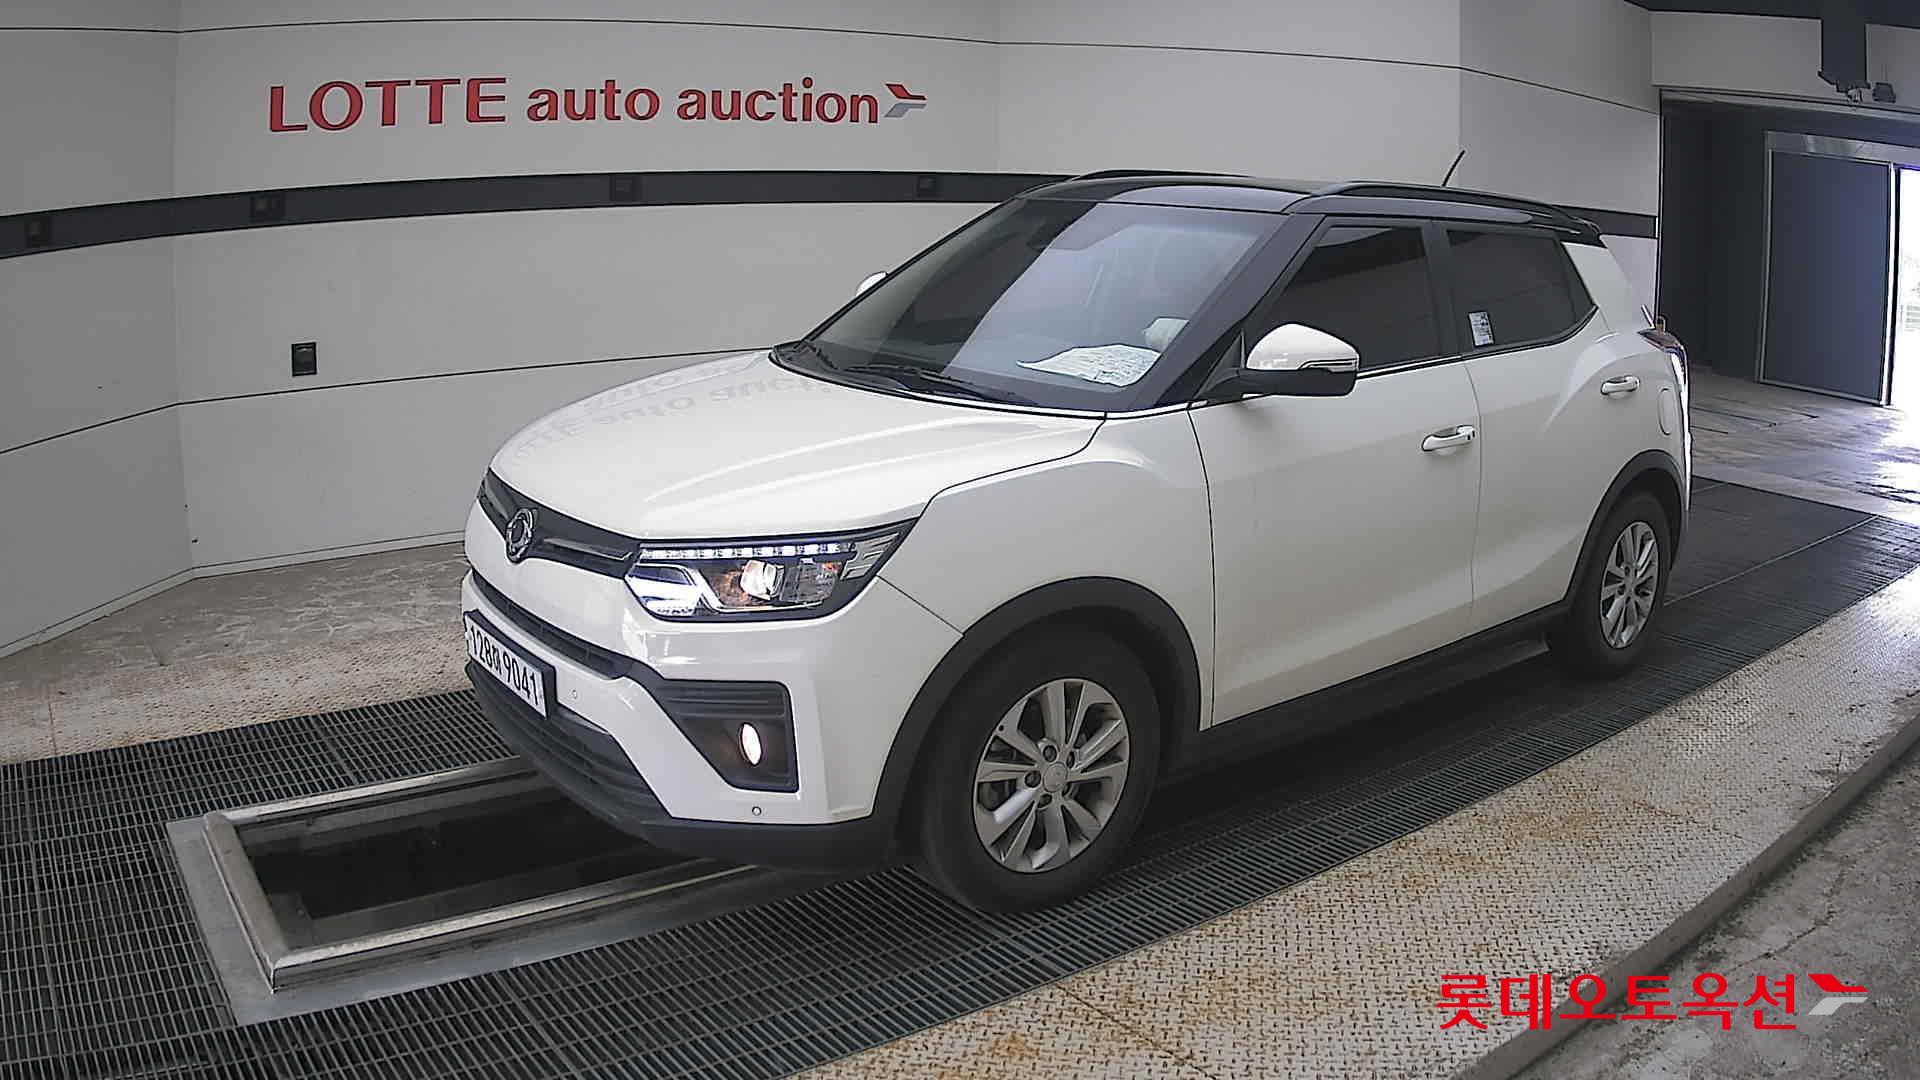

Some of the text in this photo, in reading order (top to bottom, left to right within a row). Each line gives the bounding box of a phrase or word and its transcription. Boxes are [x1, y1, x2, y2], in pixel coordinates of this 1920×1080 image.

[269, 77, 879, 132] LOTTE auto auction
[503, 651, 539, 707] 9041
